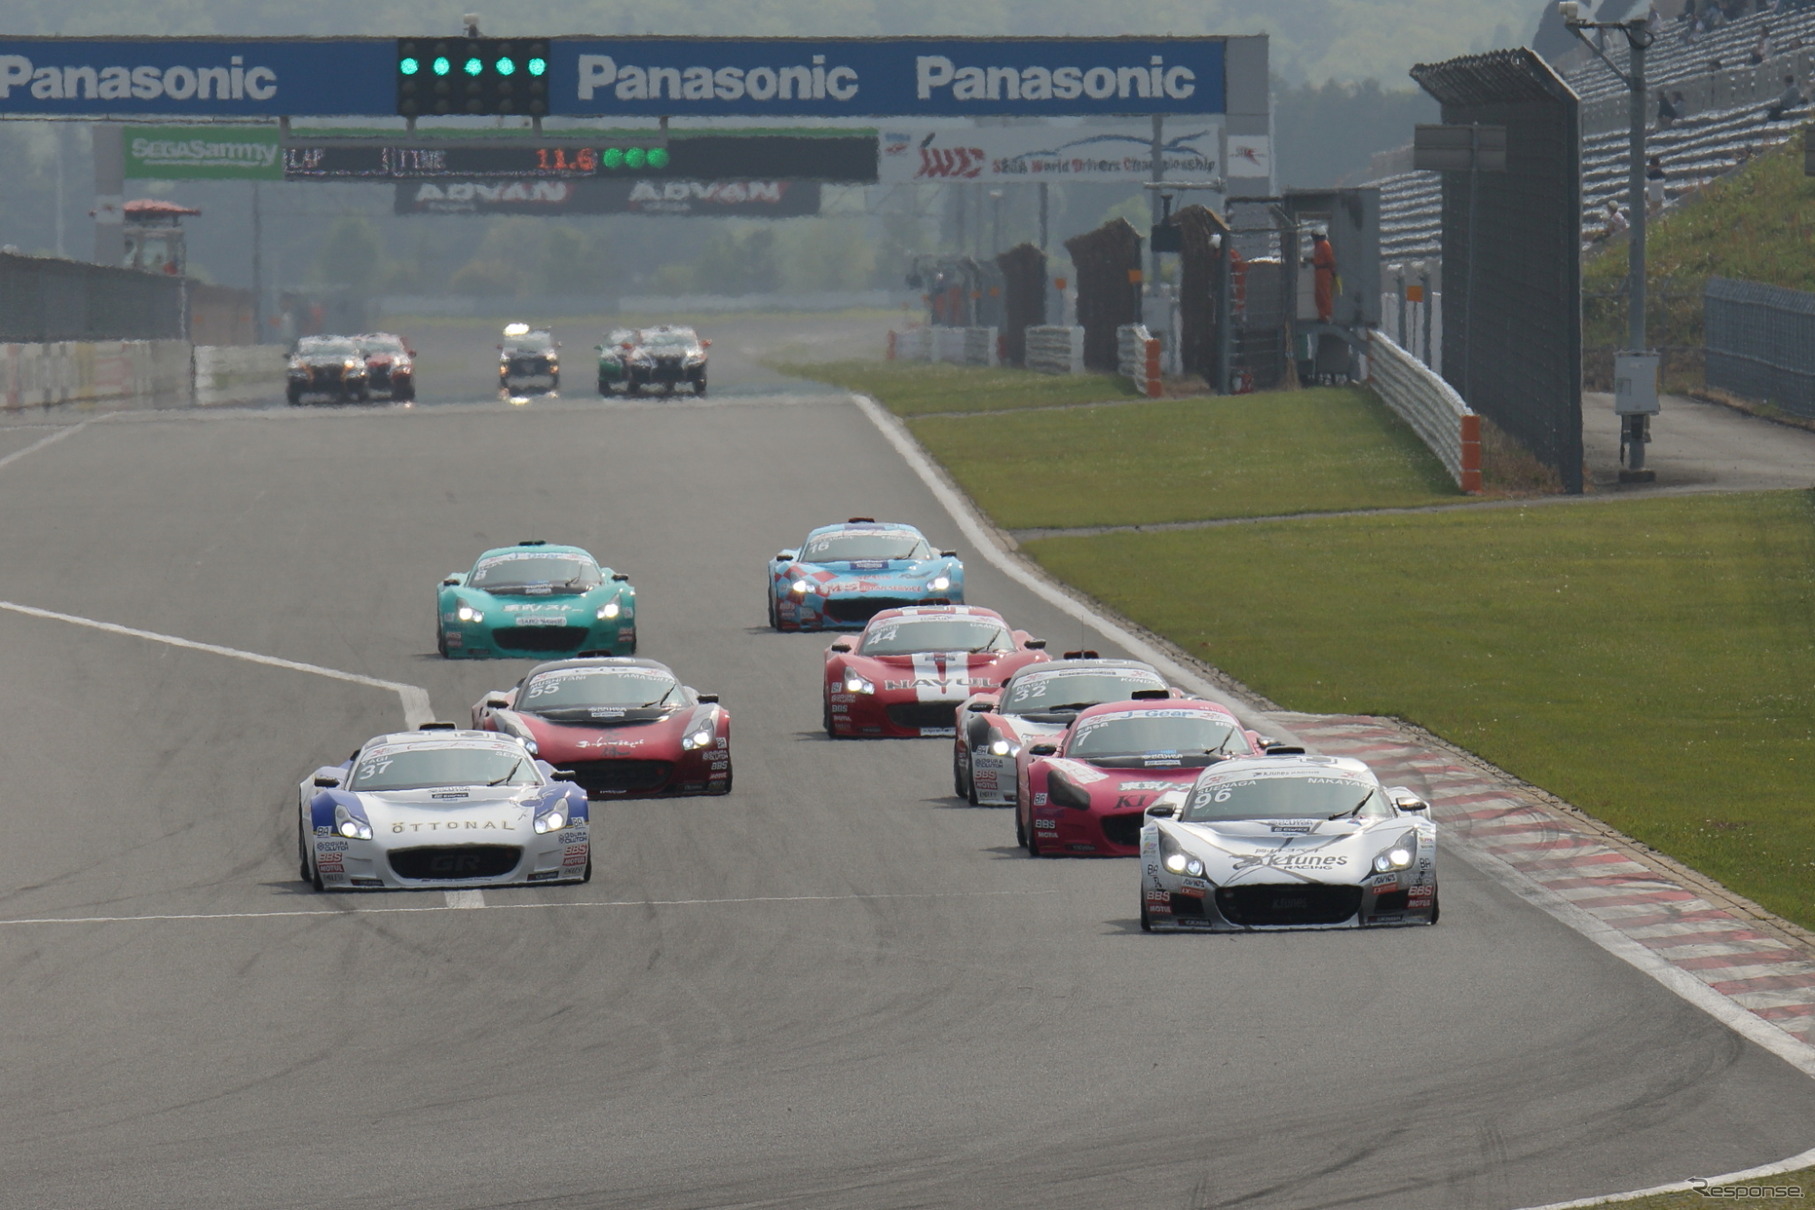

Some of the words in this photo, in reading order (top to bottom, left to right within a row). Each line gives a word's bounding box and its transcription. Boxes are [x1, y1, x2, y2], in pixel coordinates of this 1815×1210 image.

[0, 54, 277, 100] Panasonic
[577, 53, 858, 100] Panasonic
[916, 54, 1195, 100] Panasonic
[535, 148, 594, 171] 11.6
[1031, 158, 1070, 174] World
[1071, 157, 1120, 173] Drivers
[415, 181, 568, 201] ADVAN
[629, 180, 781, 202] ADVAN
[867, 629, 897, 646] 44
[529, 683, 560, 698] 55
[1014, 686, 1047, 702] 32
[1016, 680, 1050, 691] NAGAI
[1076, 729, 1093, 747] 7
[360, 760, 394, 780] 37
[975, 770, 997, 779] BBS
[1198, 780, 1257, 794] SUENAGA
[1193, 788, 1233, 810] 96
[1035, 819, 1056, 829] BBS
[319, 852, 342, 862] BBS
[564, 844, 588, 854] BBS
[1146, 890, 1171, 902] BBS
[1408, 885, 1433, 896] BBS
